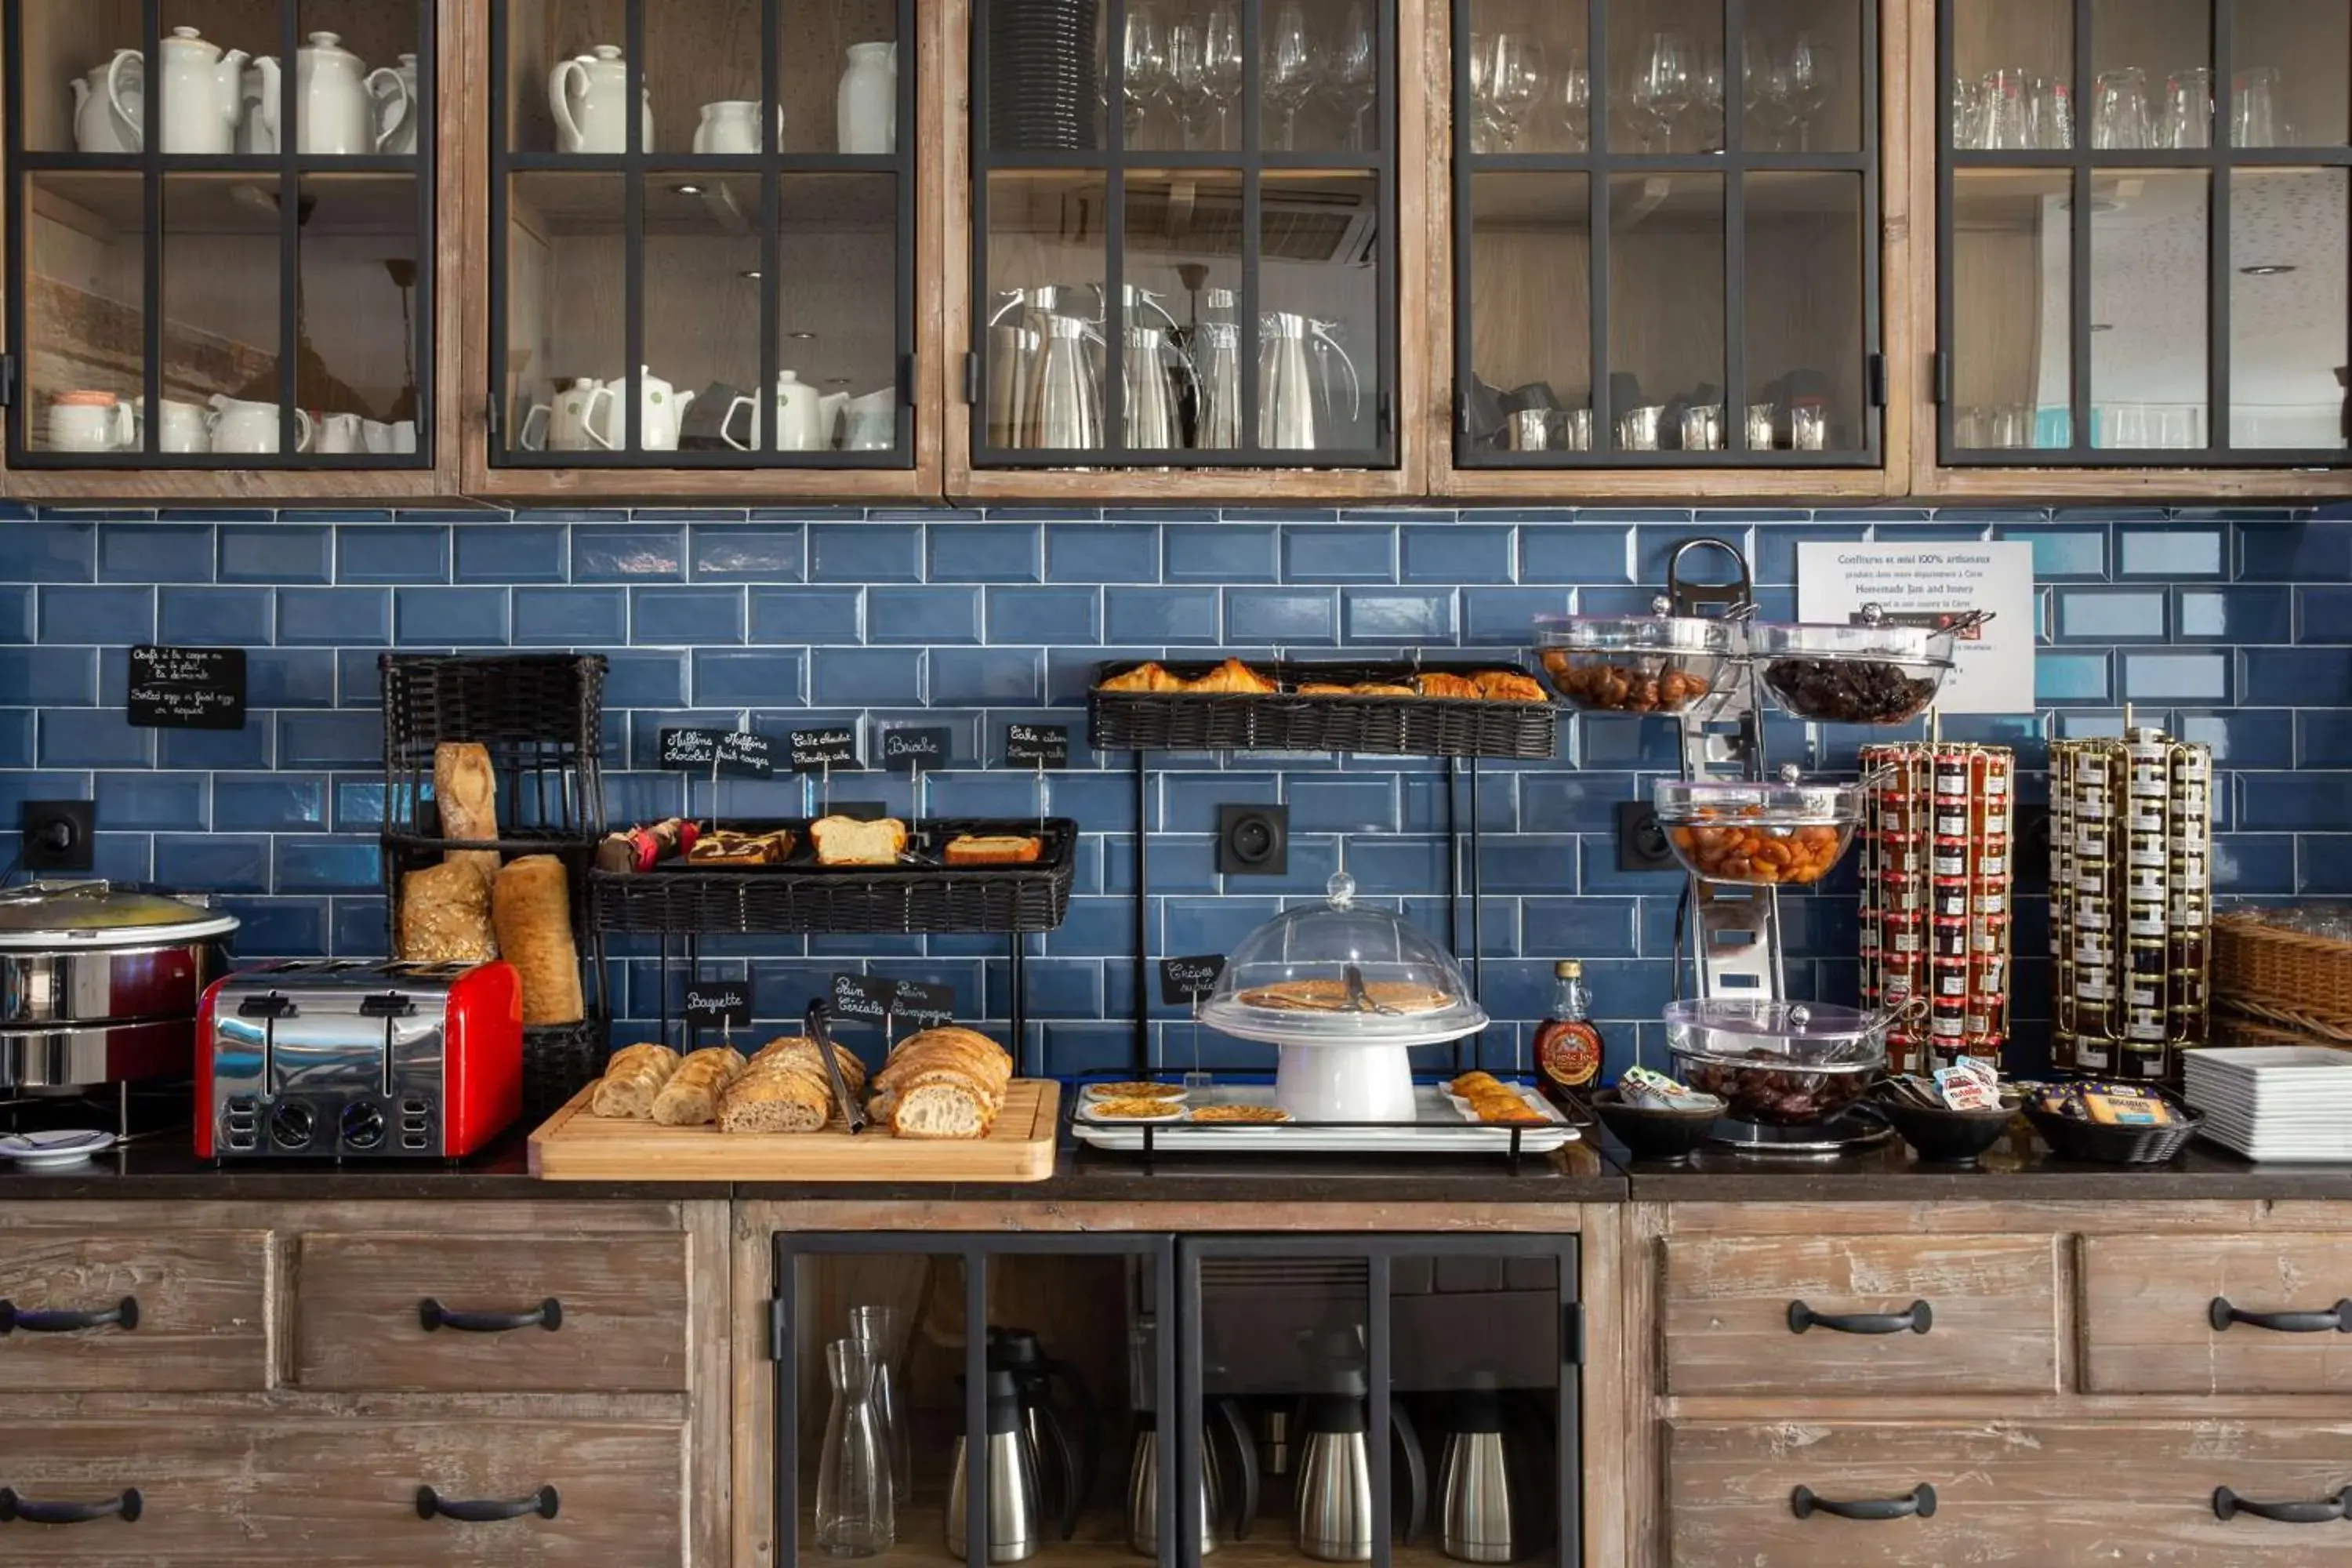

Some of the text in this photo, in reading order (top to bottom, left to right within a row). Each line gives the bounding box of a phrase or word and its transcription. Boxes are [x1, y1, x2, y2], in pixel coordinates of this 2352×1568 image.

[1918, 554, 1943, 564] 100%
[1856, 584, 1904, 593] Homemade
[1927, 584, 1944, 593] and
[667, 729, 713, 753] Muffins
[724, 731, 768, 752] Muffins
[887, 735, 939, 756] Brioche
[835, 976, 866, 997] Pain
[896, 980, 928, 999] Pain
[688, 991, 743, 1014] Baguette
